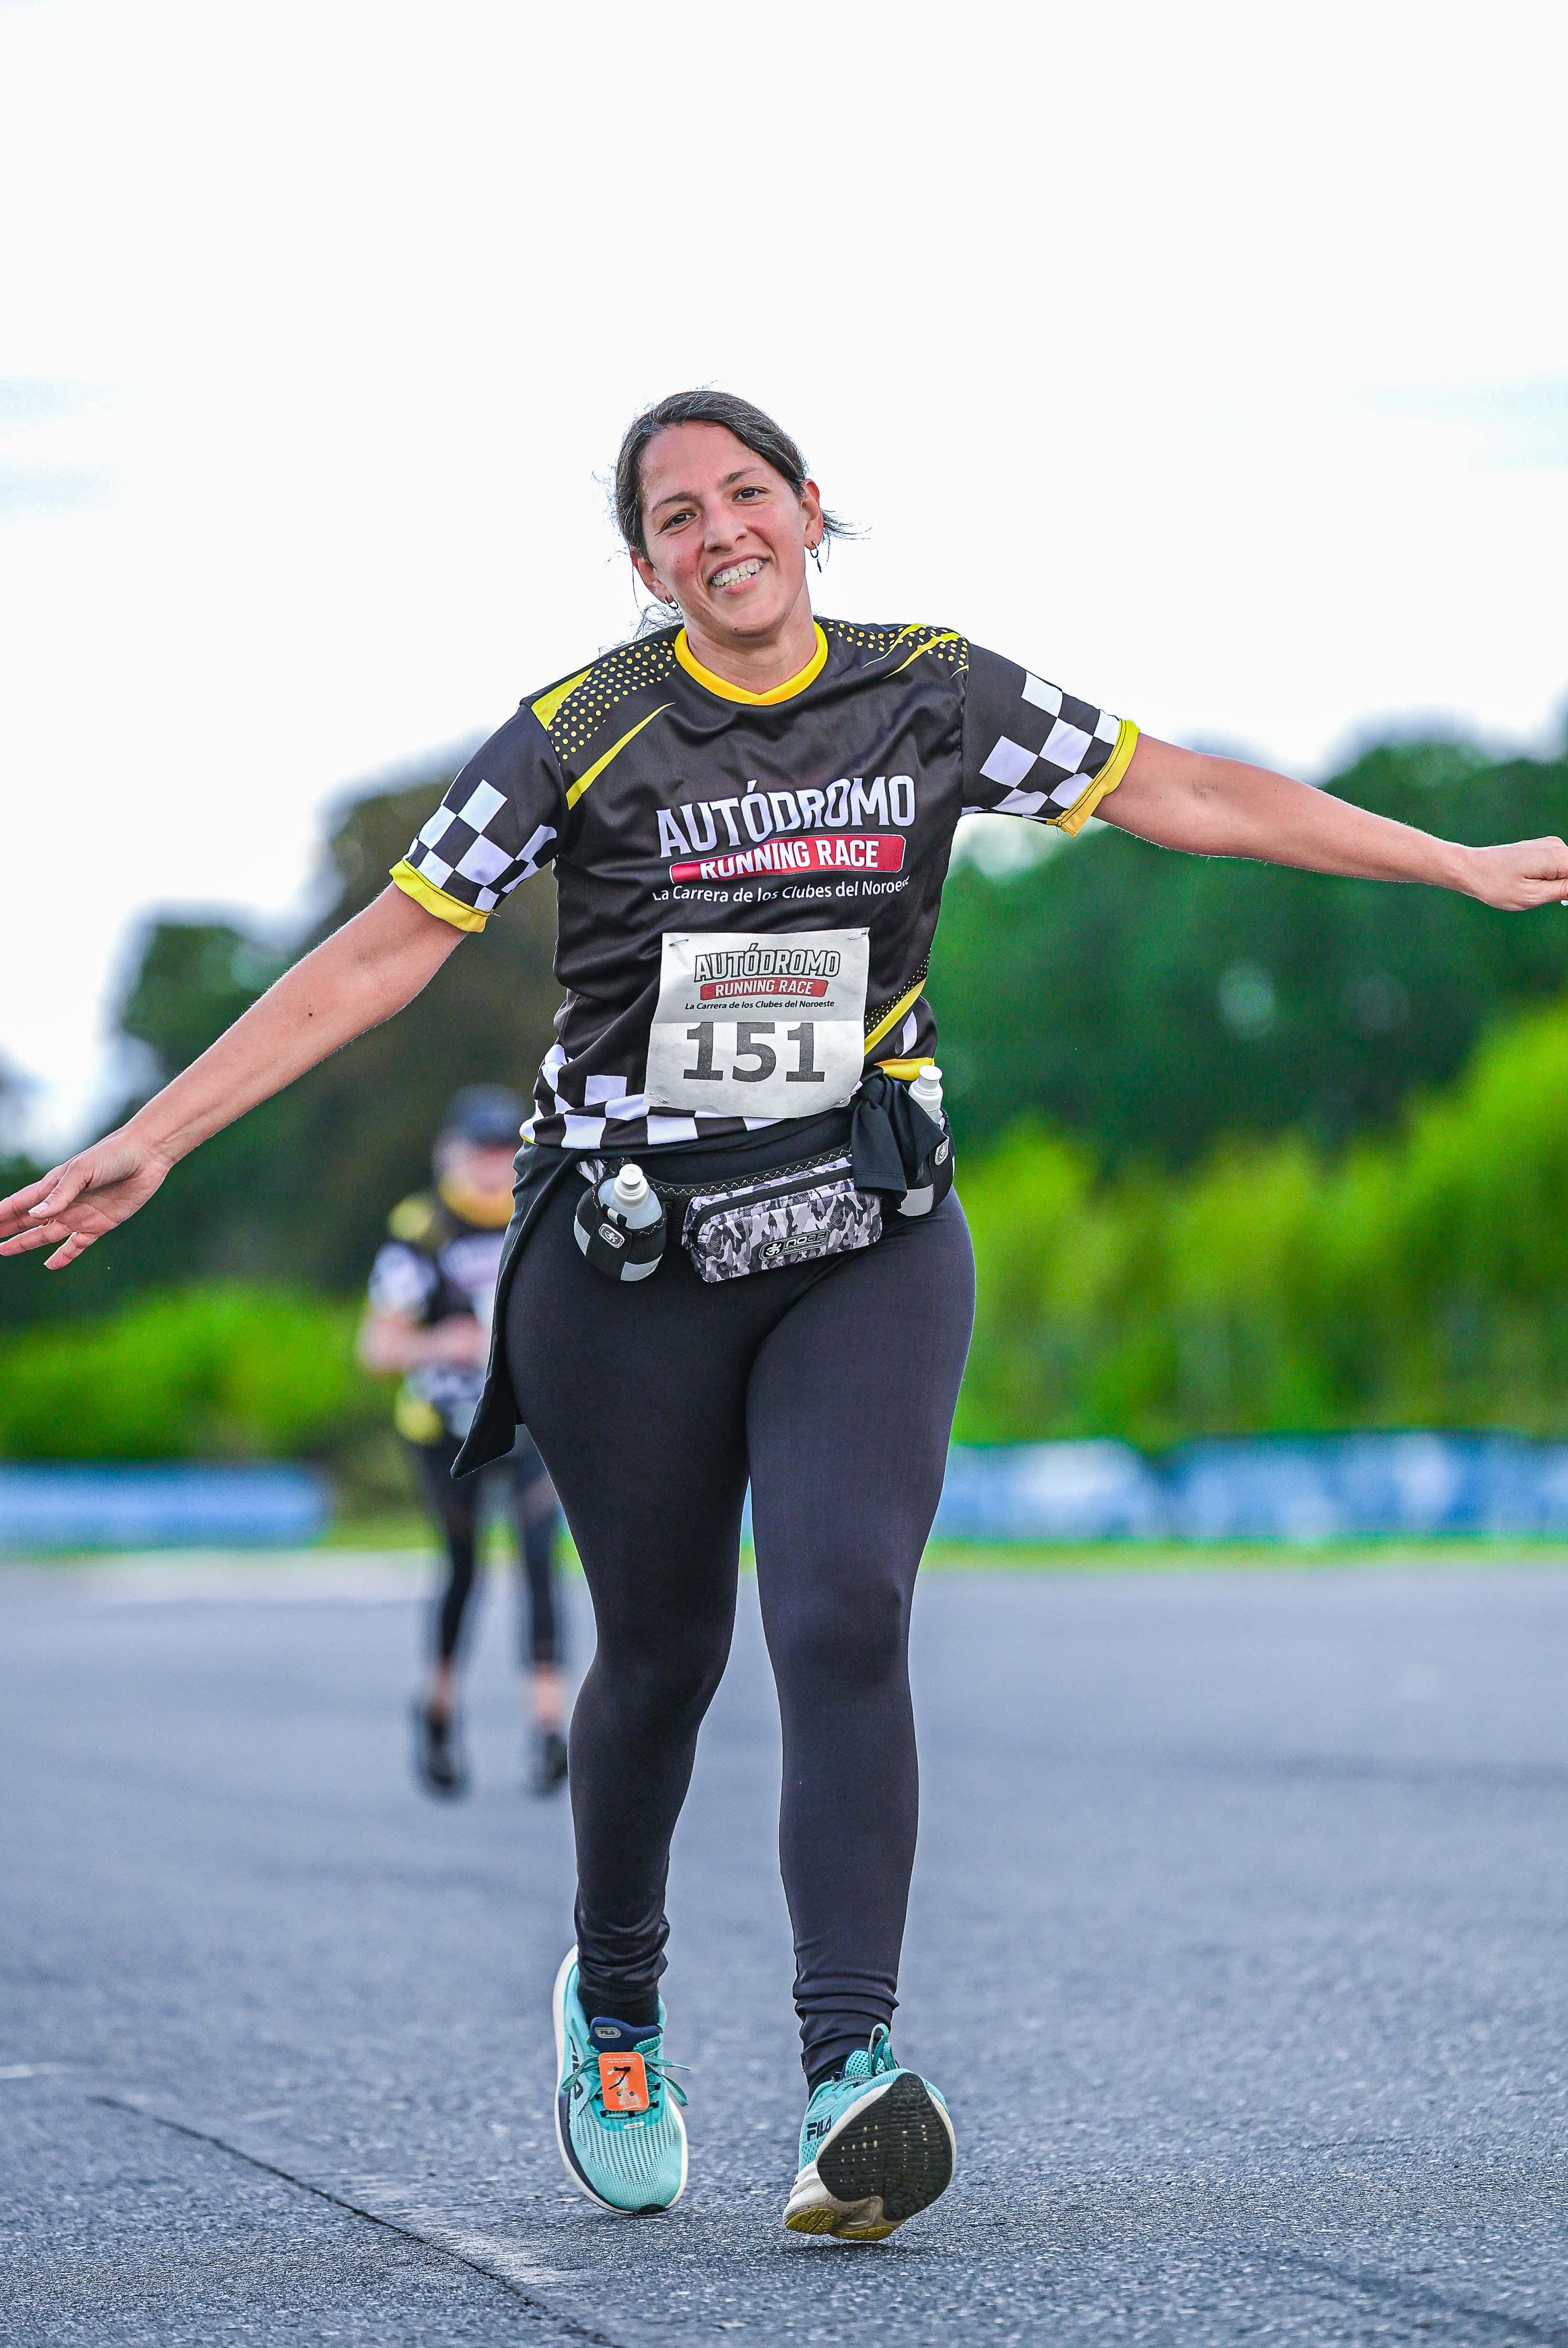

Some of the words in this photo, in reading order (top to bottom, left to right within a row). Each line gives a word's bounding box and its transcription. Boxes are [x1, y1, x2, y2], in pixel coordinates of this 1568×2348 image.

[655, 774, 915, 858] AUTÓDROMO
[700, 841, 810, 880] RUNNING
[815, 839, 879, 868] RACE
[653, 890, 669, 901] La
[673, 886, 728, 902] Carrera
[733, 888, 753, 902] de
[758, 887, 779, 902] los
[782, 884, 831, 898] Clubes
[836, 881, 859, 897] del
[862, 876, 910, 896] Noroe
[694, 943, 841, 983] AUTÓDROMO
[715, 979, 775, 997] RUNNING
[778, 979, 814, 995] RACE
[683, 1021, 825, 1082] 151
[807, 2115, 831, 2142] FILA
